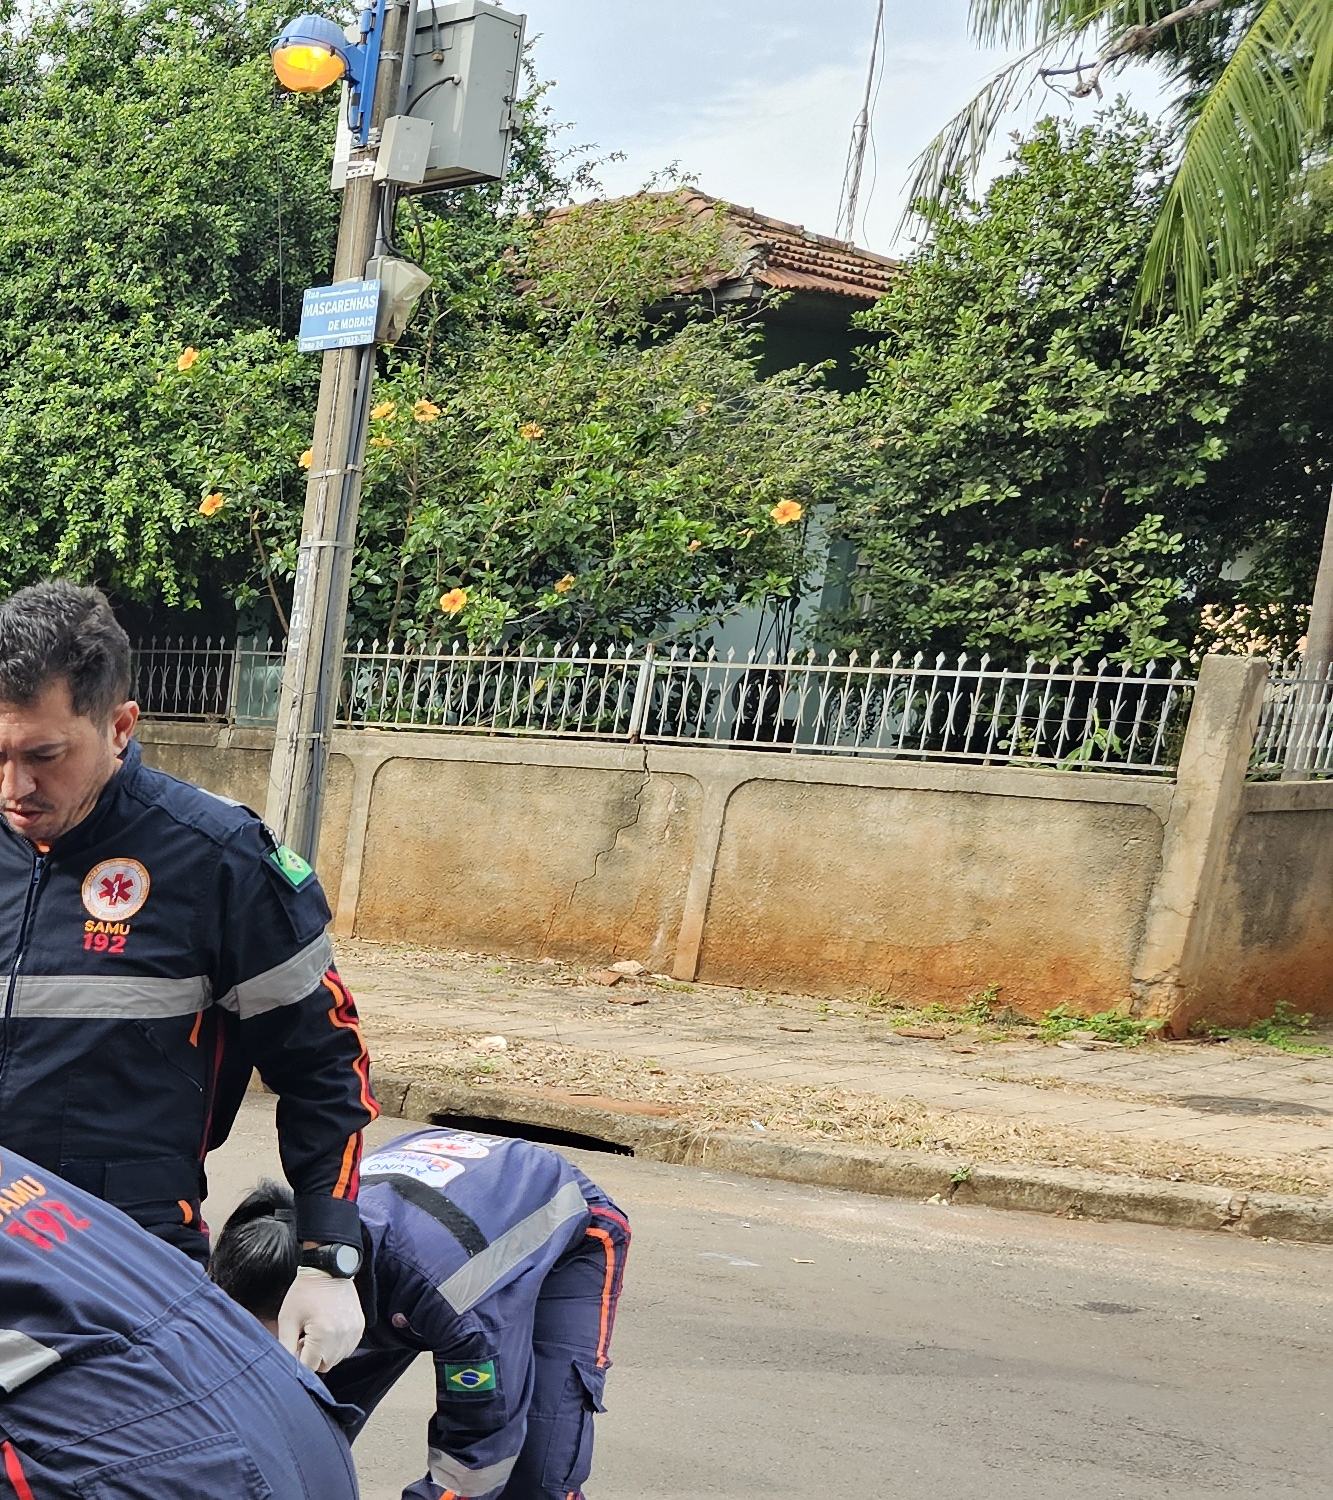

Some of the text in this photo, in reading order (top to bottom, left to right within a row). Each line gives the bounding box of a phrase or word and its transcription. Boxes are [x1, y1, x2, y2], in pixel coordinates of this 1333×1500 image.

[306, 290, 320, 299] Rua
[304, 295, 377, 317] MASCARENHAS
[328, 315, 374, 331] DE MORAIS
[84, 920, 131, 935] SAMU
[83, 932, 127, 954] 192
[4, 1200, 92, 1251] 192
